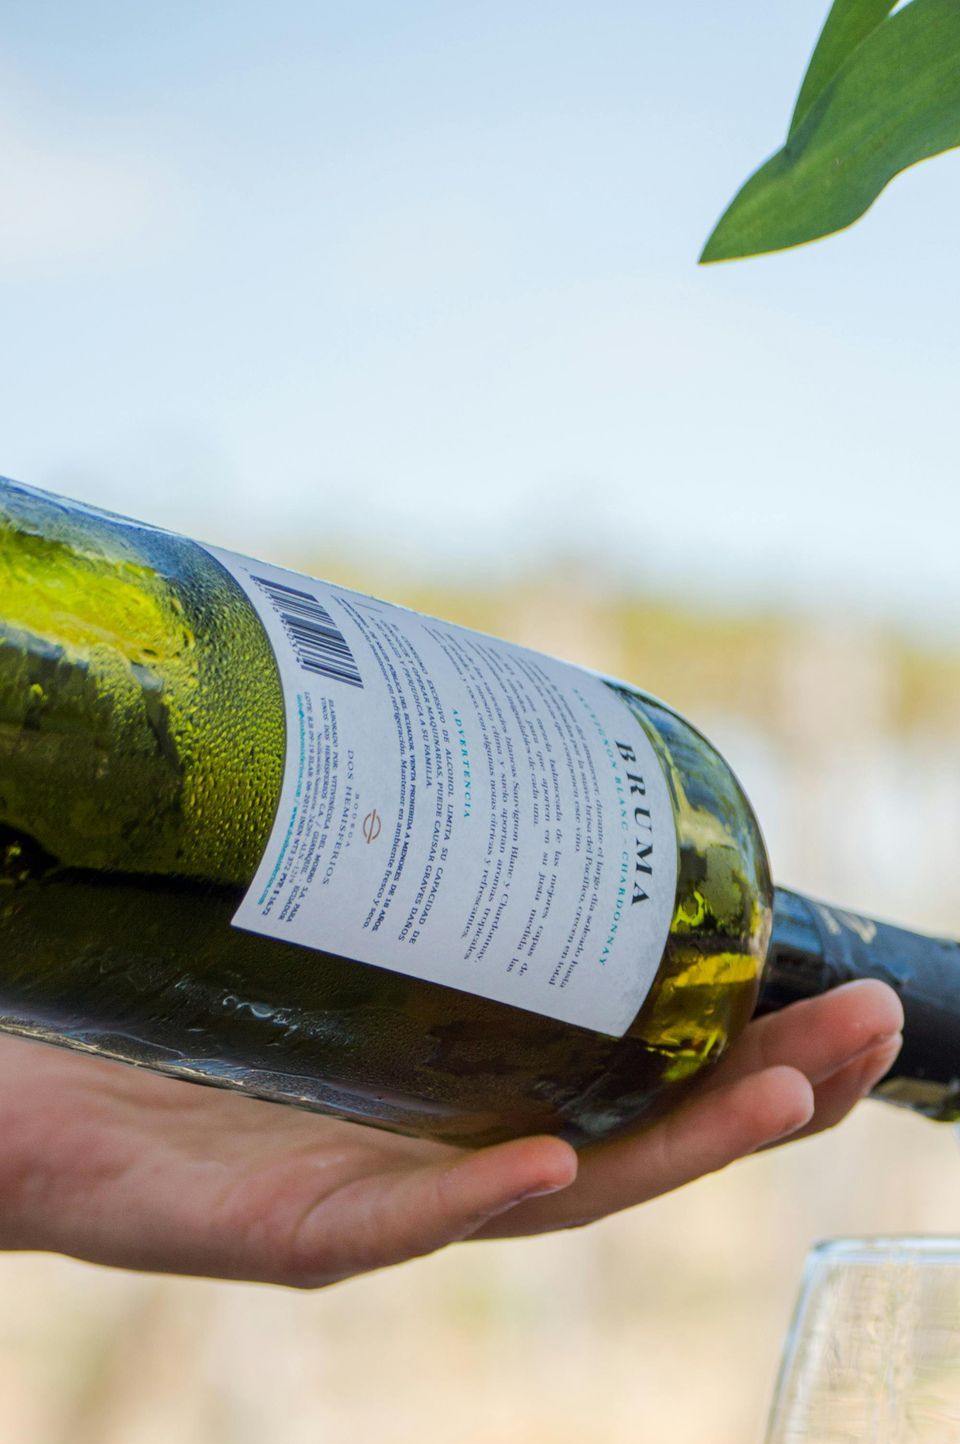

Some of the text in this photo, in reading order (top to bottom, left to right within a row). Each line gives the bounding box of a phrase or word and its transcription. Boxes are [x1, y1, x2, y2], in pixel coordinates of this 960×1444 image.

[384, 662, 406, 695] PÚBLICA
[399, 665, 426, 717] PERJUDICA
[408, 665, 432, 704] OPERAR
[398, 694, 408, 712] DEL
[424, 677, 448, 725] EXCESIVO
[421, 727, 429, 742] SU
[425, 704, 443, 781] MAQUINARIAS,
[441, 728, 451, 744] DE
[422, 743, 432, 790] FAMILIA.
[444, 748, 454, 799] ALCOHOL
[450, 707, 470, 819] ADVERTENCIA
[480, 732, 497, 778] algunas
[560, 740, 580, 800] componen
[397, 758, 408, 806] Mantener
[434, 781, 444, 818] PUEDE
[489, 778, 498, 813] notas
[500, 772, 509, 804] suelo
[529, 772, 540, 800] cada
[540, 776, 551, 822] aporten
[548, 758, 563, 822] balanceada
[321, 749, 354, 886] DOS HEMISFERIOS
[344, 792, 360, 848] BODEGA
[397, 808, 405, 821] en
[404, 782, 417, 831] PROHIBIDA
[442, 802, 454, 842] LIMITA
[510, 780, 521, 842] Sauvignon
[595, 798, 604, 845] durante
[613, 775, 629, 832] BLANC
[317, 833, 327, 850] DEL
[426, 819, 441, 863] CAUSAR
[485, 812, 498, 856] cítricas
[496, 806, 509, 854] aportan
[543, 829, 551, 845] en
[554, 827, 563, 845] de
[585, 834, 593, 855] del
[613, 739, 653, 911] BRUMA
[386, 822, 404, 868] ambiente
[391, 839, 410, 882] MENORES
[438, 846, 449, 862] SU
[505, 845, 518, 879] Blanc
[540, 851, 549, 866] su
[552, 849, 561, 868] las
[304, 853, 321, 883] MORRO
[375, 869, 393, 899] fresco
[413, 863, 433, 905] GRAVES
[486, 858, 503, 903] aromas
[532, 870, 546, 902] justa
[577, 855, 593, 905] Pacífico,
[591, 860, 603, 891] largo
[370, 898, 380, 906] y
[382, 897, 392, 908] 18
[386, 883, 397, 897] DE
[417, 865, 444, 926] CAPACIDAD
[459, 868, 491, 941] refrescantes.
[539, 873, 558, 920] mejores
[588, 892, 598, 912] día
[597, 850, 629, 967] CHARDONNAY
[285, 902, 301, 923] PARA
[361, 906, 378, 930] seco.
[396, 906, 420, 942] DAÑOS
[472, 892, 509, 965] Chardonnay,
[516, 908, 537, 951] medida
[565, 904, 583, 945] crecen
[407, 929, 421, 944] DE
[461, 906, 492, 961] tropicales
[525, 923, 544, 957] capas
[559, 944, 570, 960] en
[573, 914, 593, 958] soleado
[504, 956, 519, 973] las
[516, 962, 530, 977] de
[546, 960, 565, 986] total
[558, 959, 578, 989] hasta
